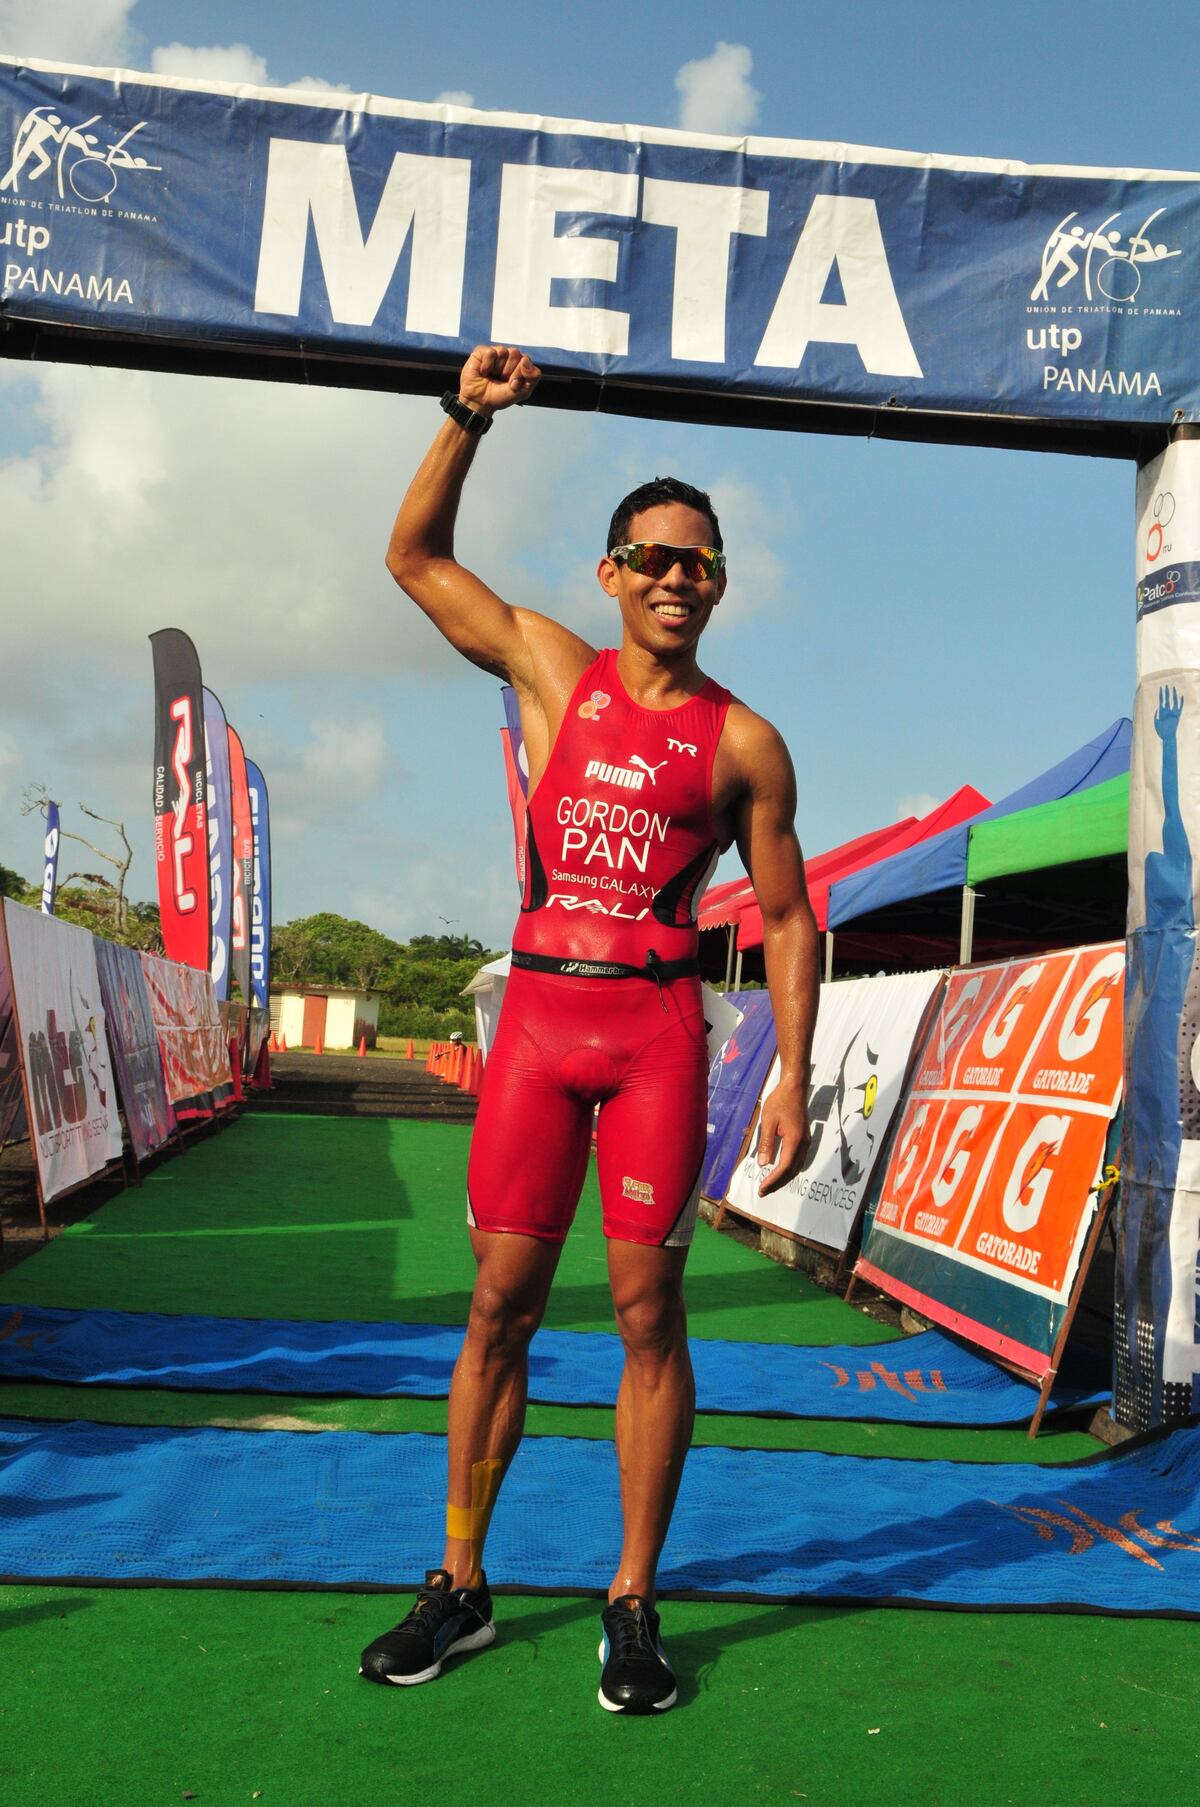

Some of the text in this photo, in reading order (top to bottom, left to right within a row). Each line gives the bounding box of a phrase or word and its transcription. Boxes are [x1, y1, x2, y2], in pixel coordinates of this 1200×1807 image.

[31, 200, 43, 209] DE
[102, 209, 113, 218] DE
[254, 137, 924, 378] META
[4, 264, 134, 304] PANAMA
[1027, 324, 1082, 357] utp
[1044, 366, 1162, 396] PANAMA
[667, 738, 698, 757] TYR
[585, 760, 646, 790] PUMA
[155, 766, 165, 863] CALIDAD SERVICIO
[195, 771, 204, 829] BICICLETAS
[557, 796, 670, 843] GORDON
[561, 828, 650, 873] PAN
[552, 869, 661, 900] Samsung GALAXY
[983, 962, 1046, 1059] G
[1058, 952, 1125, 1061] G
[963, 1067, 1004, 1087] GATORADE
[1033, 1069, 1096, 1094] GATORADE
[931, 1105, 985, 1207] G
[1002, 1114, 1074, 1233] G
[976, 1232, 1042, 1275] GATORADE
